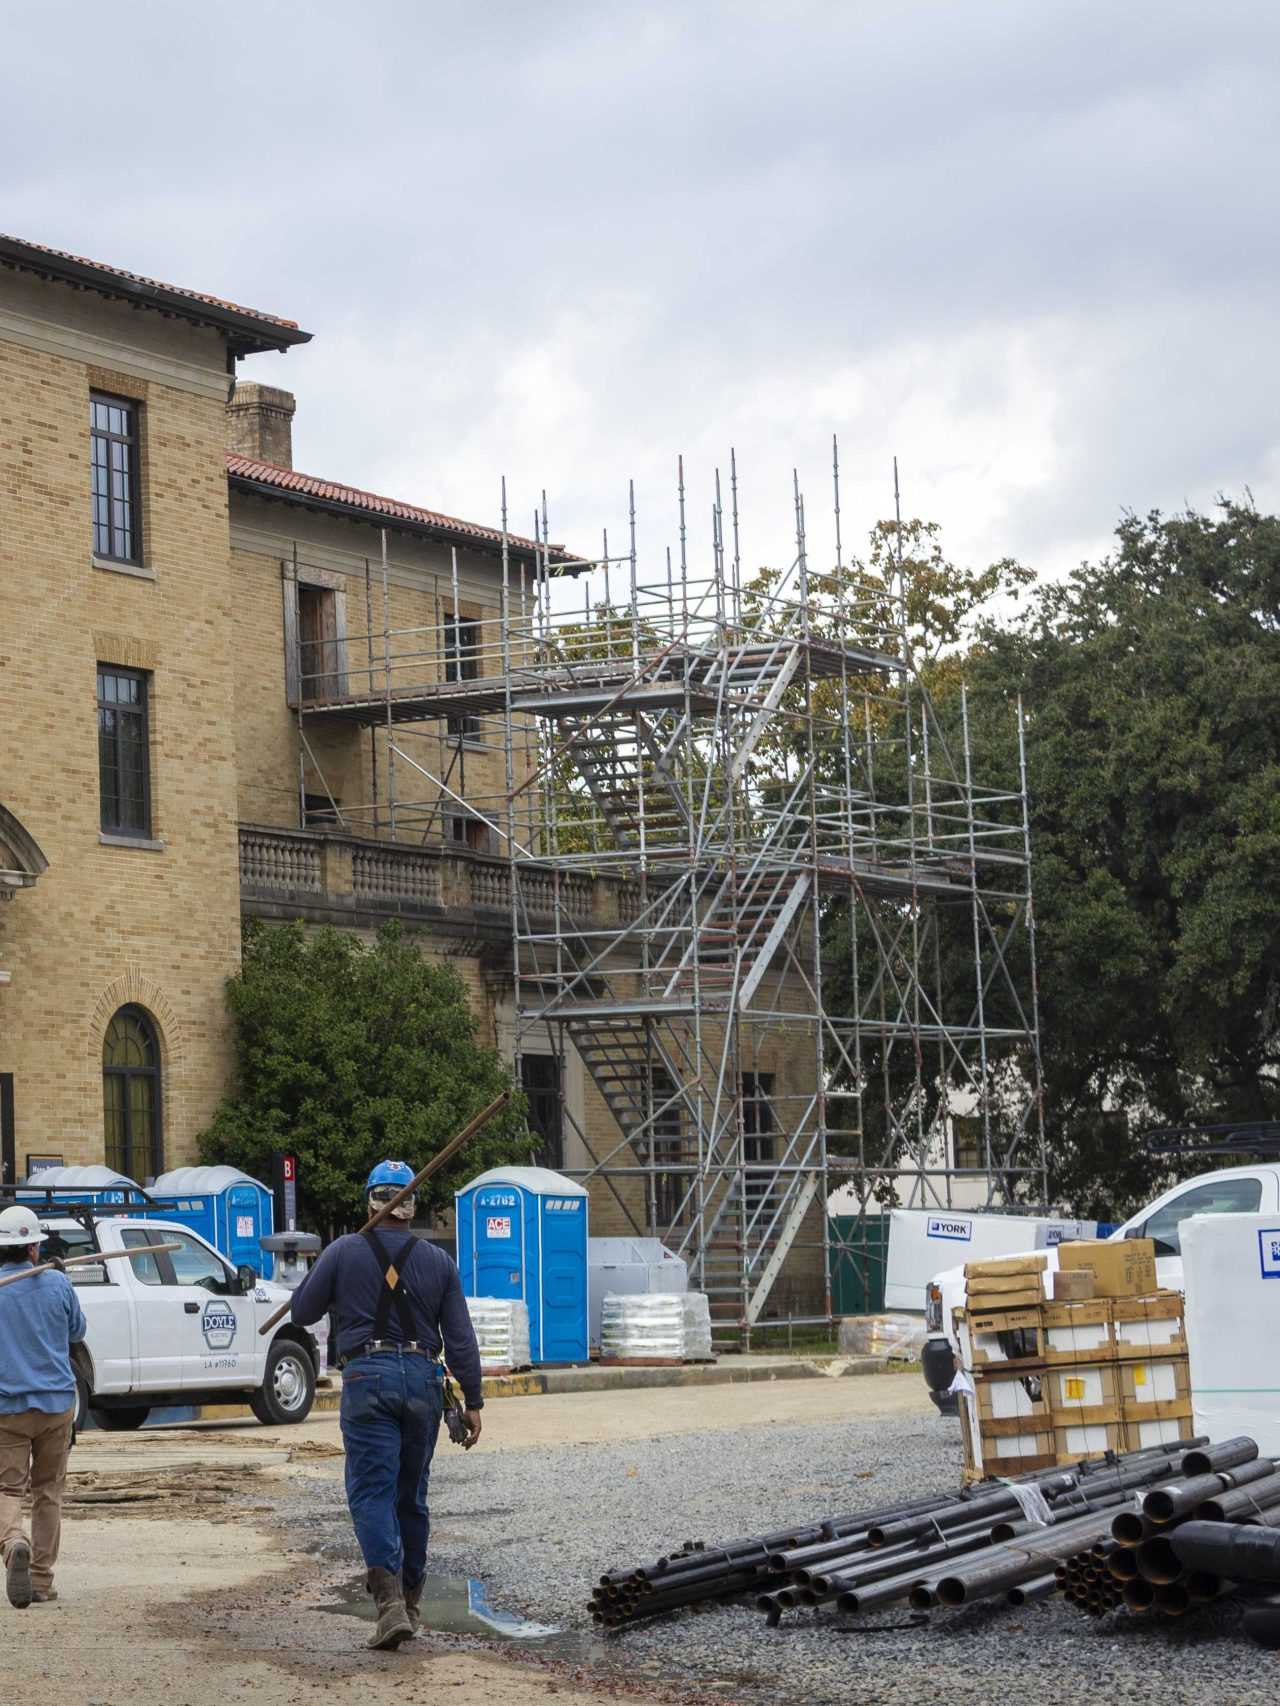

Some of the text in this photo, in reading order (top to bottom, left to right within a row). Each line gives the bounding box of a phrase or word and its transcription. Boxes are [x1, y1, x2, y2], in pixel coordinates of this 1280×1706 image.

[284, 1160, 292, 1178] B
[487, 1218, 510, 1231] ACE
[941, 1223, 967, 1234] YORK
[203, 1316, 235, 1330] DOYLE
[204, 1360, 212, 1369] LA
